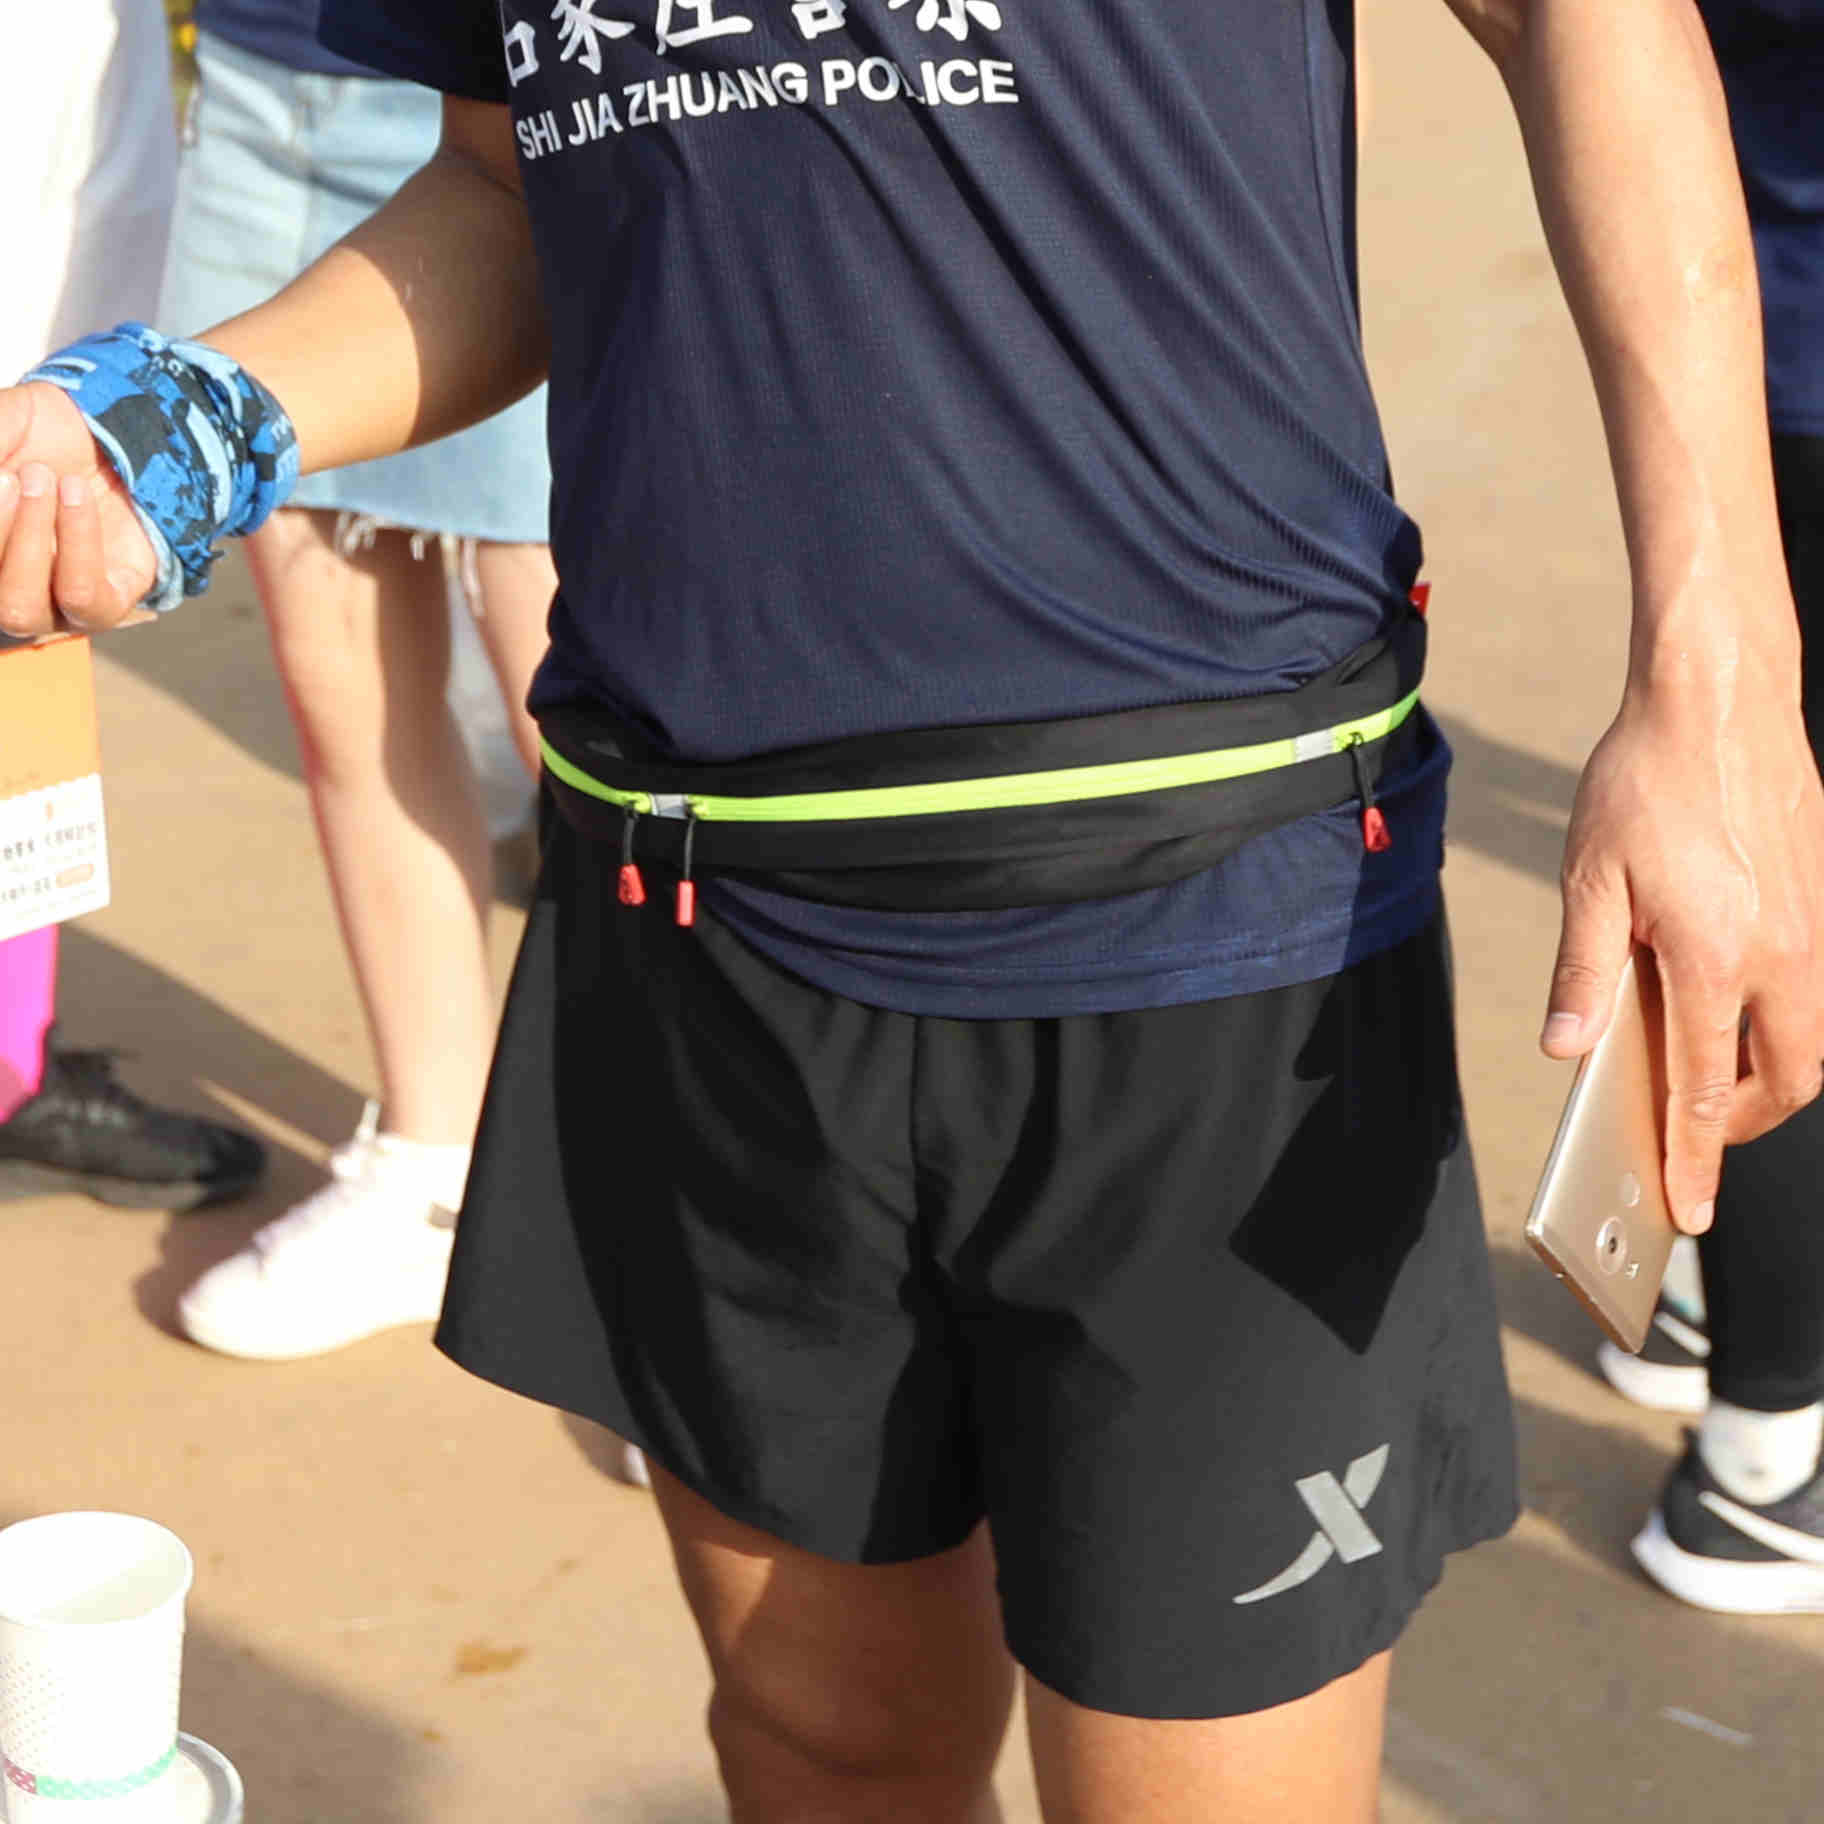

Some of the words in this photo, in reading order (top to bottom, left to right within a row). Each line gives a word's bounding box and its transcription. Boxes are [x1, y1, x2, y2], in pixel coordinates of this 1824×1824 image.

[516, 110, 562, 160] SHI
[567, 93, 625, 146] JIA
[622, 61, 809, 127] ZHUANG
